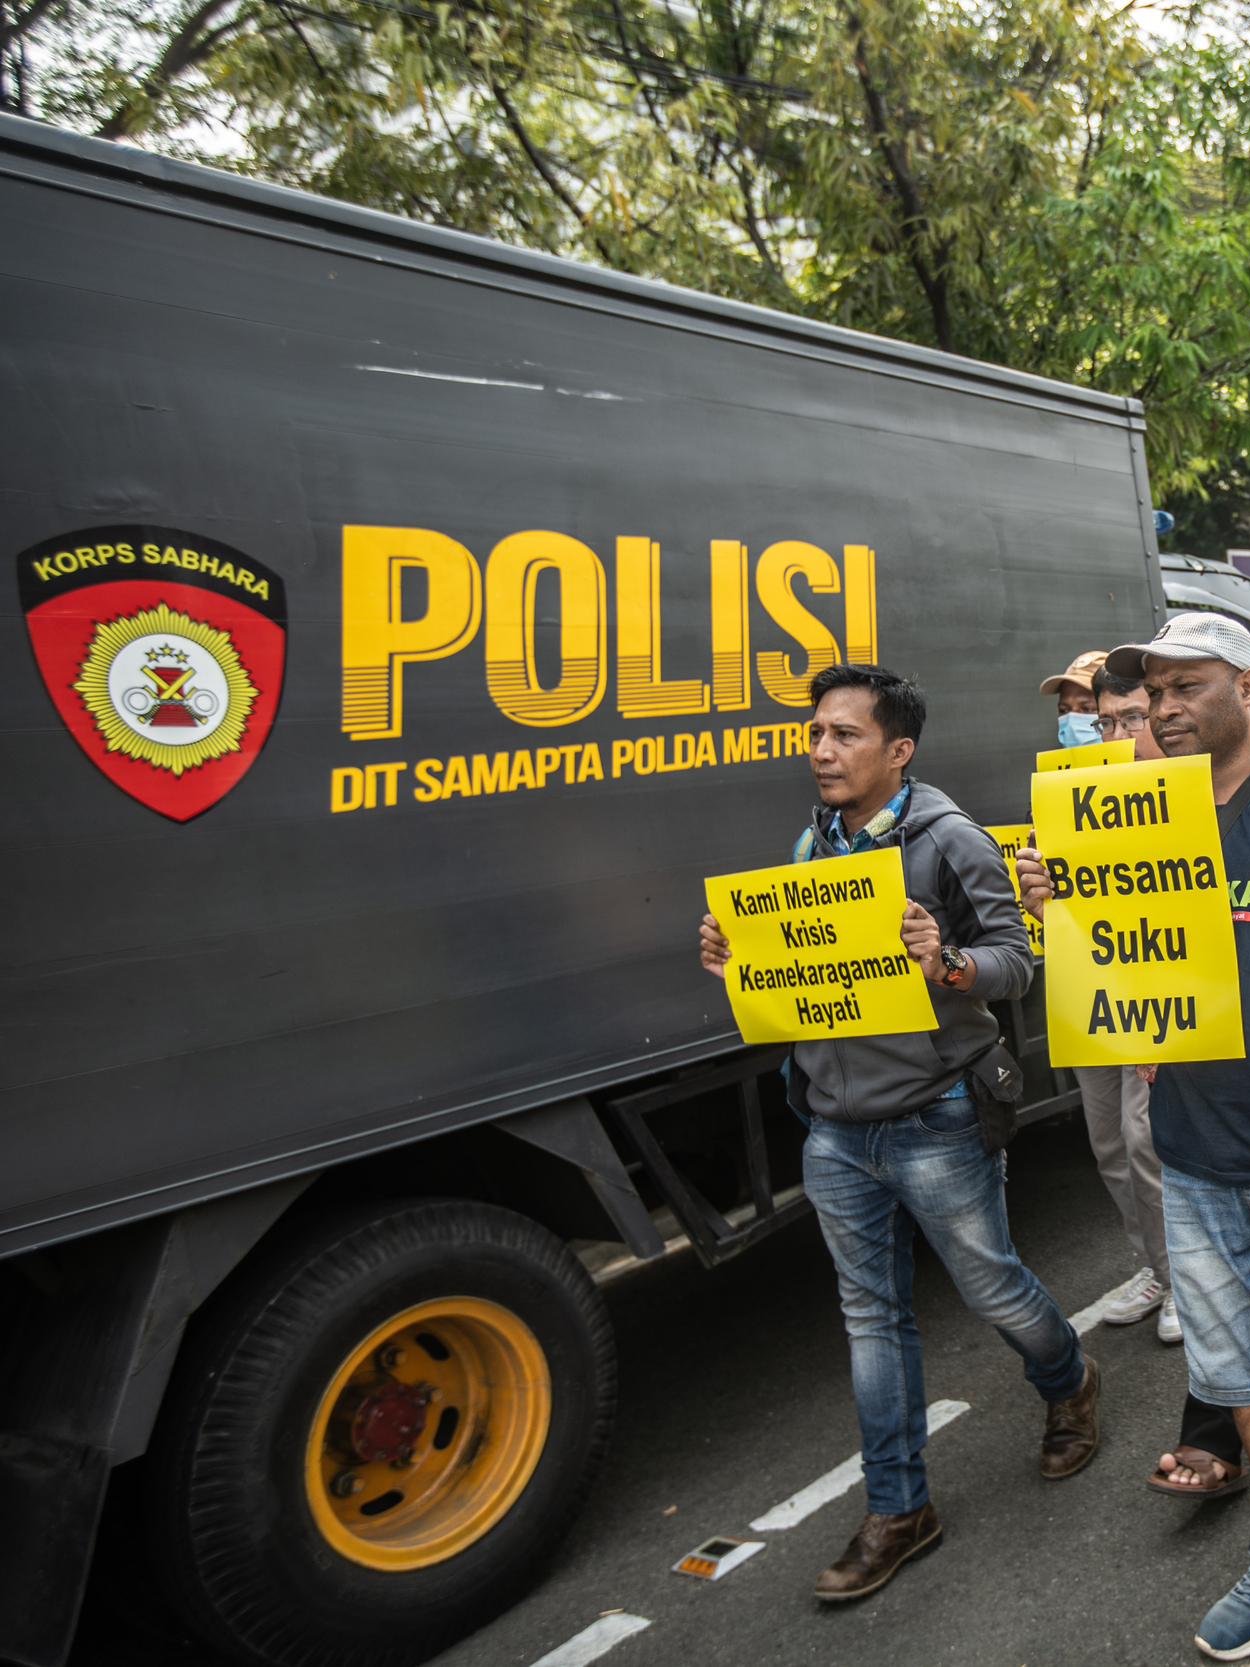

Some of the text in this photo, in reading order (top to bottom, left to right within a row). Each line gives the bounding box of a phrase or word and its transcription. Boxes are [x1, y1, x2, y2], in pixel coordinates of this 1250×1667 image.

[33, 543, 270, 600] KORPS SABHARA
[341, 524, 878, 741] POLISI
[330, 761, 408, 813] DIT
[413, 743, 604, 803] SAMAPTA
[611, 731, 717, 778] POLDA
[1072, 778, 1170, 832] Kami
[731, 876, 874, 917] Kami Melawan
[1046, 855, 1218, 900] Bersama
[780, 918, 837, 949] Krisis
[1091, 917, 1187, 966] Suku
[738, 953, 910, 992] Keanekaragaman
[795, 993, 862, 1030] Hayati
[1088, 989, 1197, 1045] Awyu
